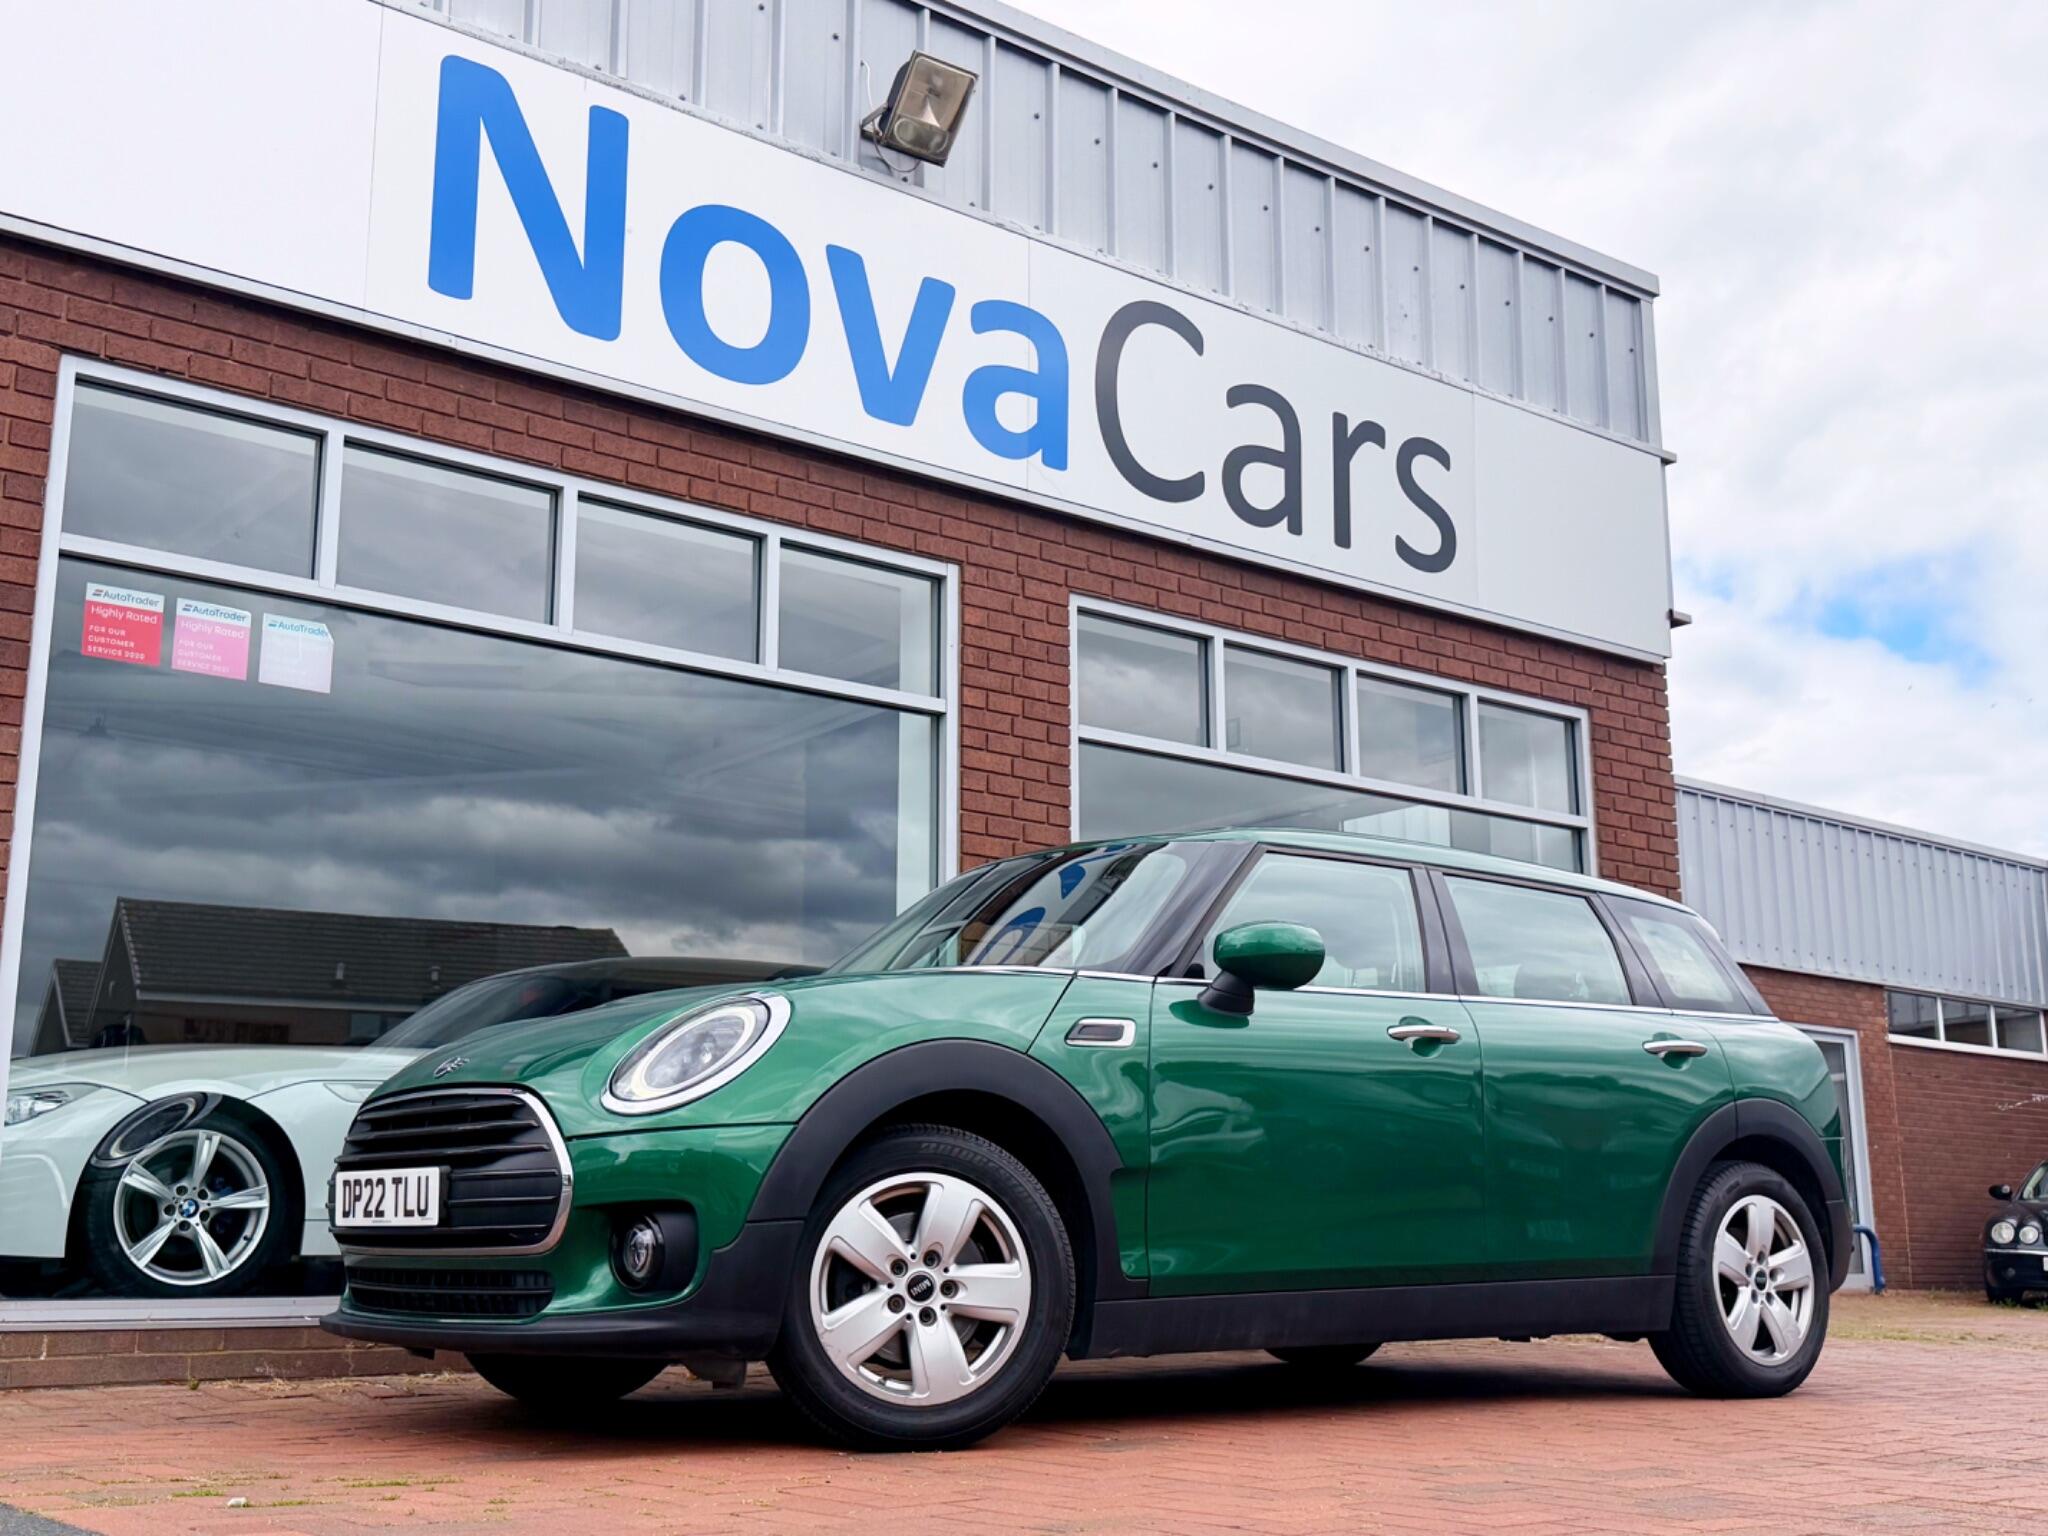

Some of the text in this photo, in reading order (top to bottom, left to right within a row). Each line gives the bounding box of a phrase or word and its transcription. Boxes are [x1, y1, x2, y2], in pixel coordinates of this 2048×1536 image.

[427, 55, 1457, 573] NovaCars
[103, 590, 160, 607] AutoTrader
[91, 605, 157, 624] Highly Rated
[192, 606, 246, 622] AutoTrader
[89, 625, 126, 636] FOR OUR
[181, 620, 244, 639] Highly Rated
[88, 635, 135, 648] CUSTOMER
[87, 645, 122, 656] SERVICE
[342, 1176, 429, 1218] DP22 TLU
